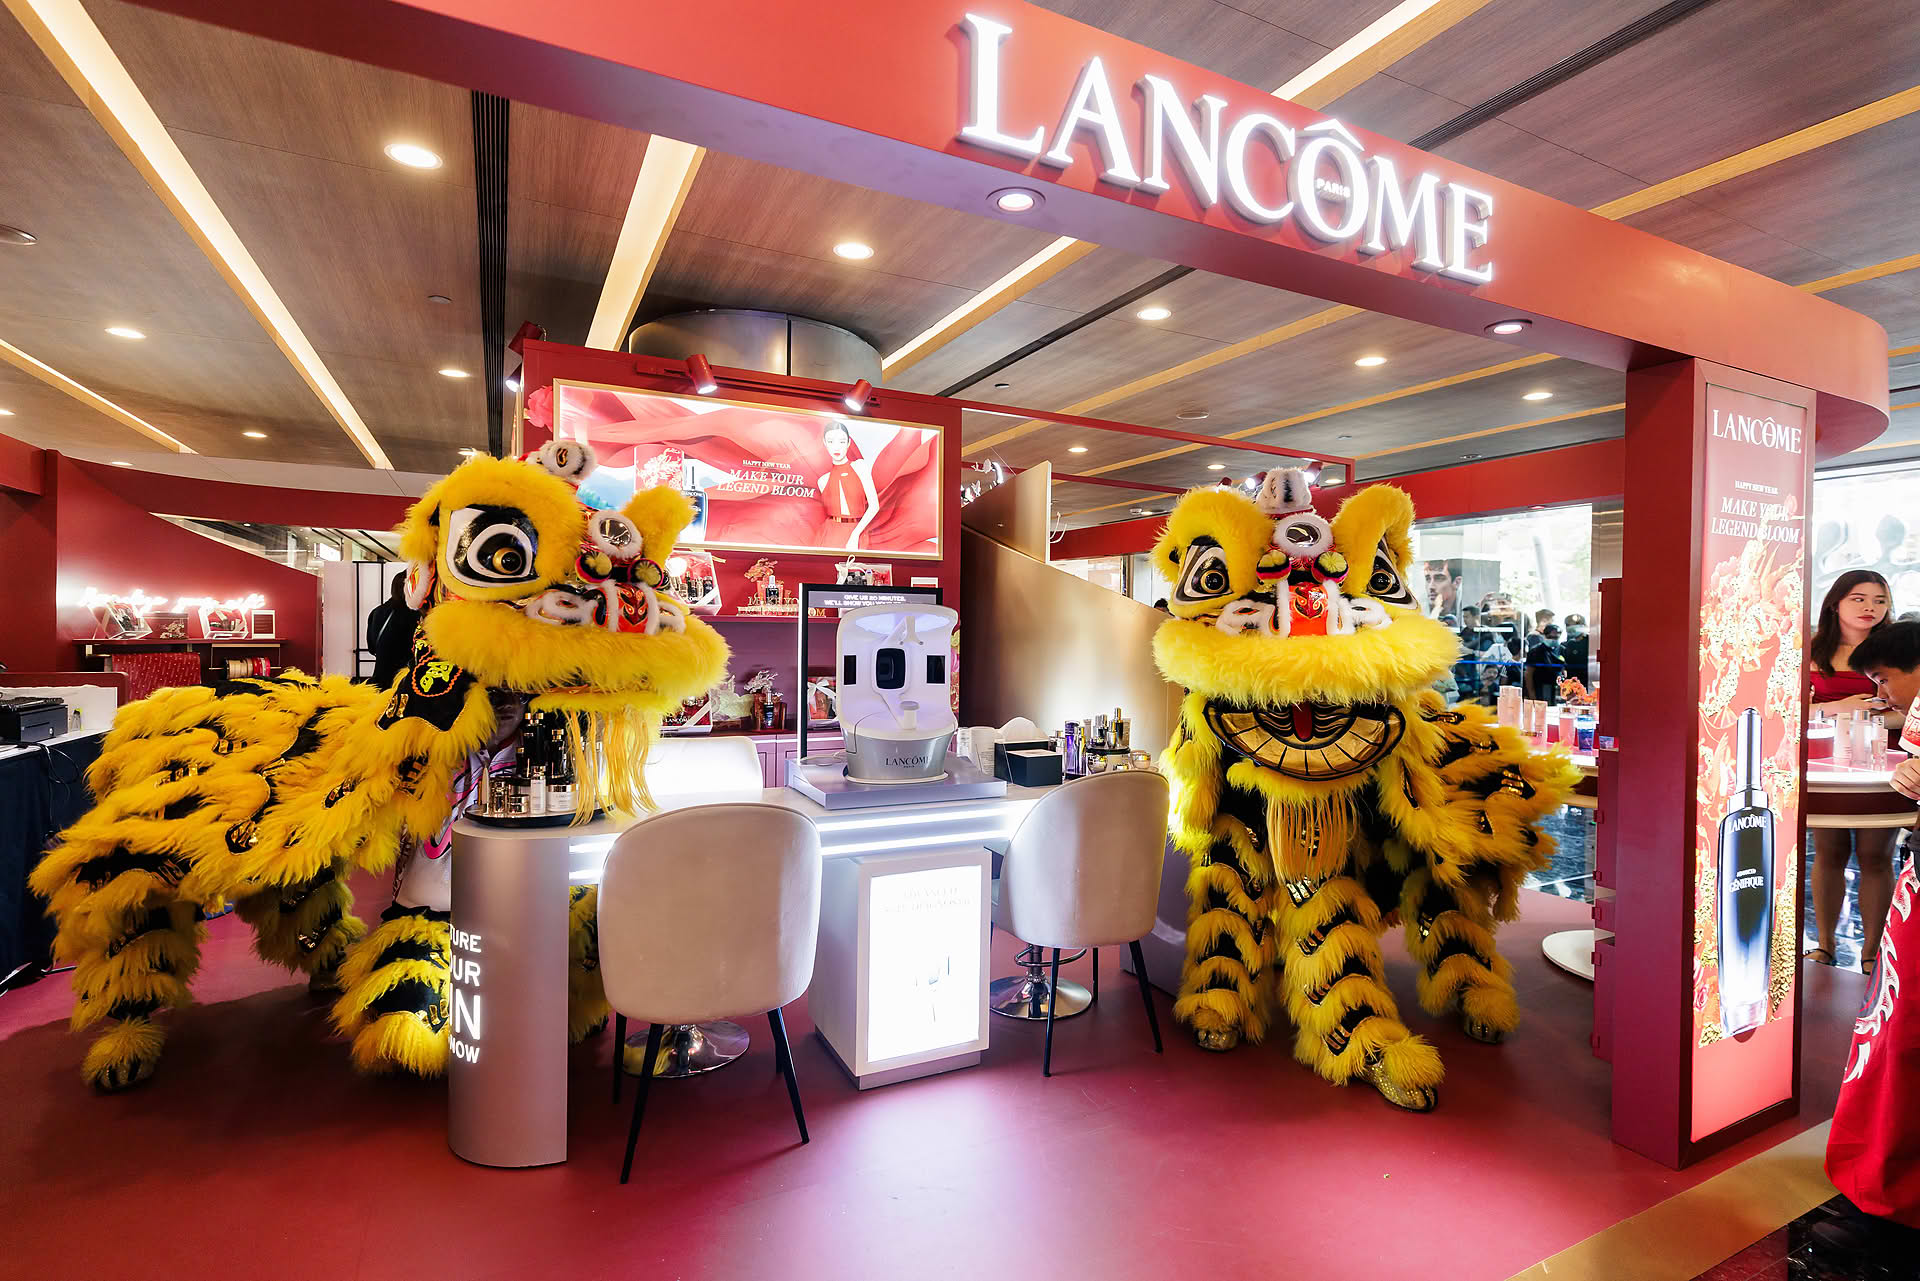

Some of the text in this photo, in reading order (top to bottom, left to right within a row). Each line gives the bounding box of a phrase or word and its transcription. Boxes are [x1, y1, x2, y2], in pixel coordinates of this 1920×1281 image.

[962, 13, 1494, 283] LANCÔME
[1316, 178, 1351, 198] PARIS
[1712, 409, 1802, 454] LANCÔME
[729, 469, 804, 485] MAKE YOUR
[717, 482, 815, 498] LEGEND BLOOM
[1721, 496, 1789, 521] MAKE YOUR
[1711, 517, 1801, 543] LEGEND BLOOM
[1729, 813, 1767, 833] LANCÔME
